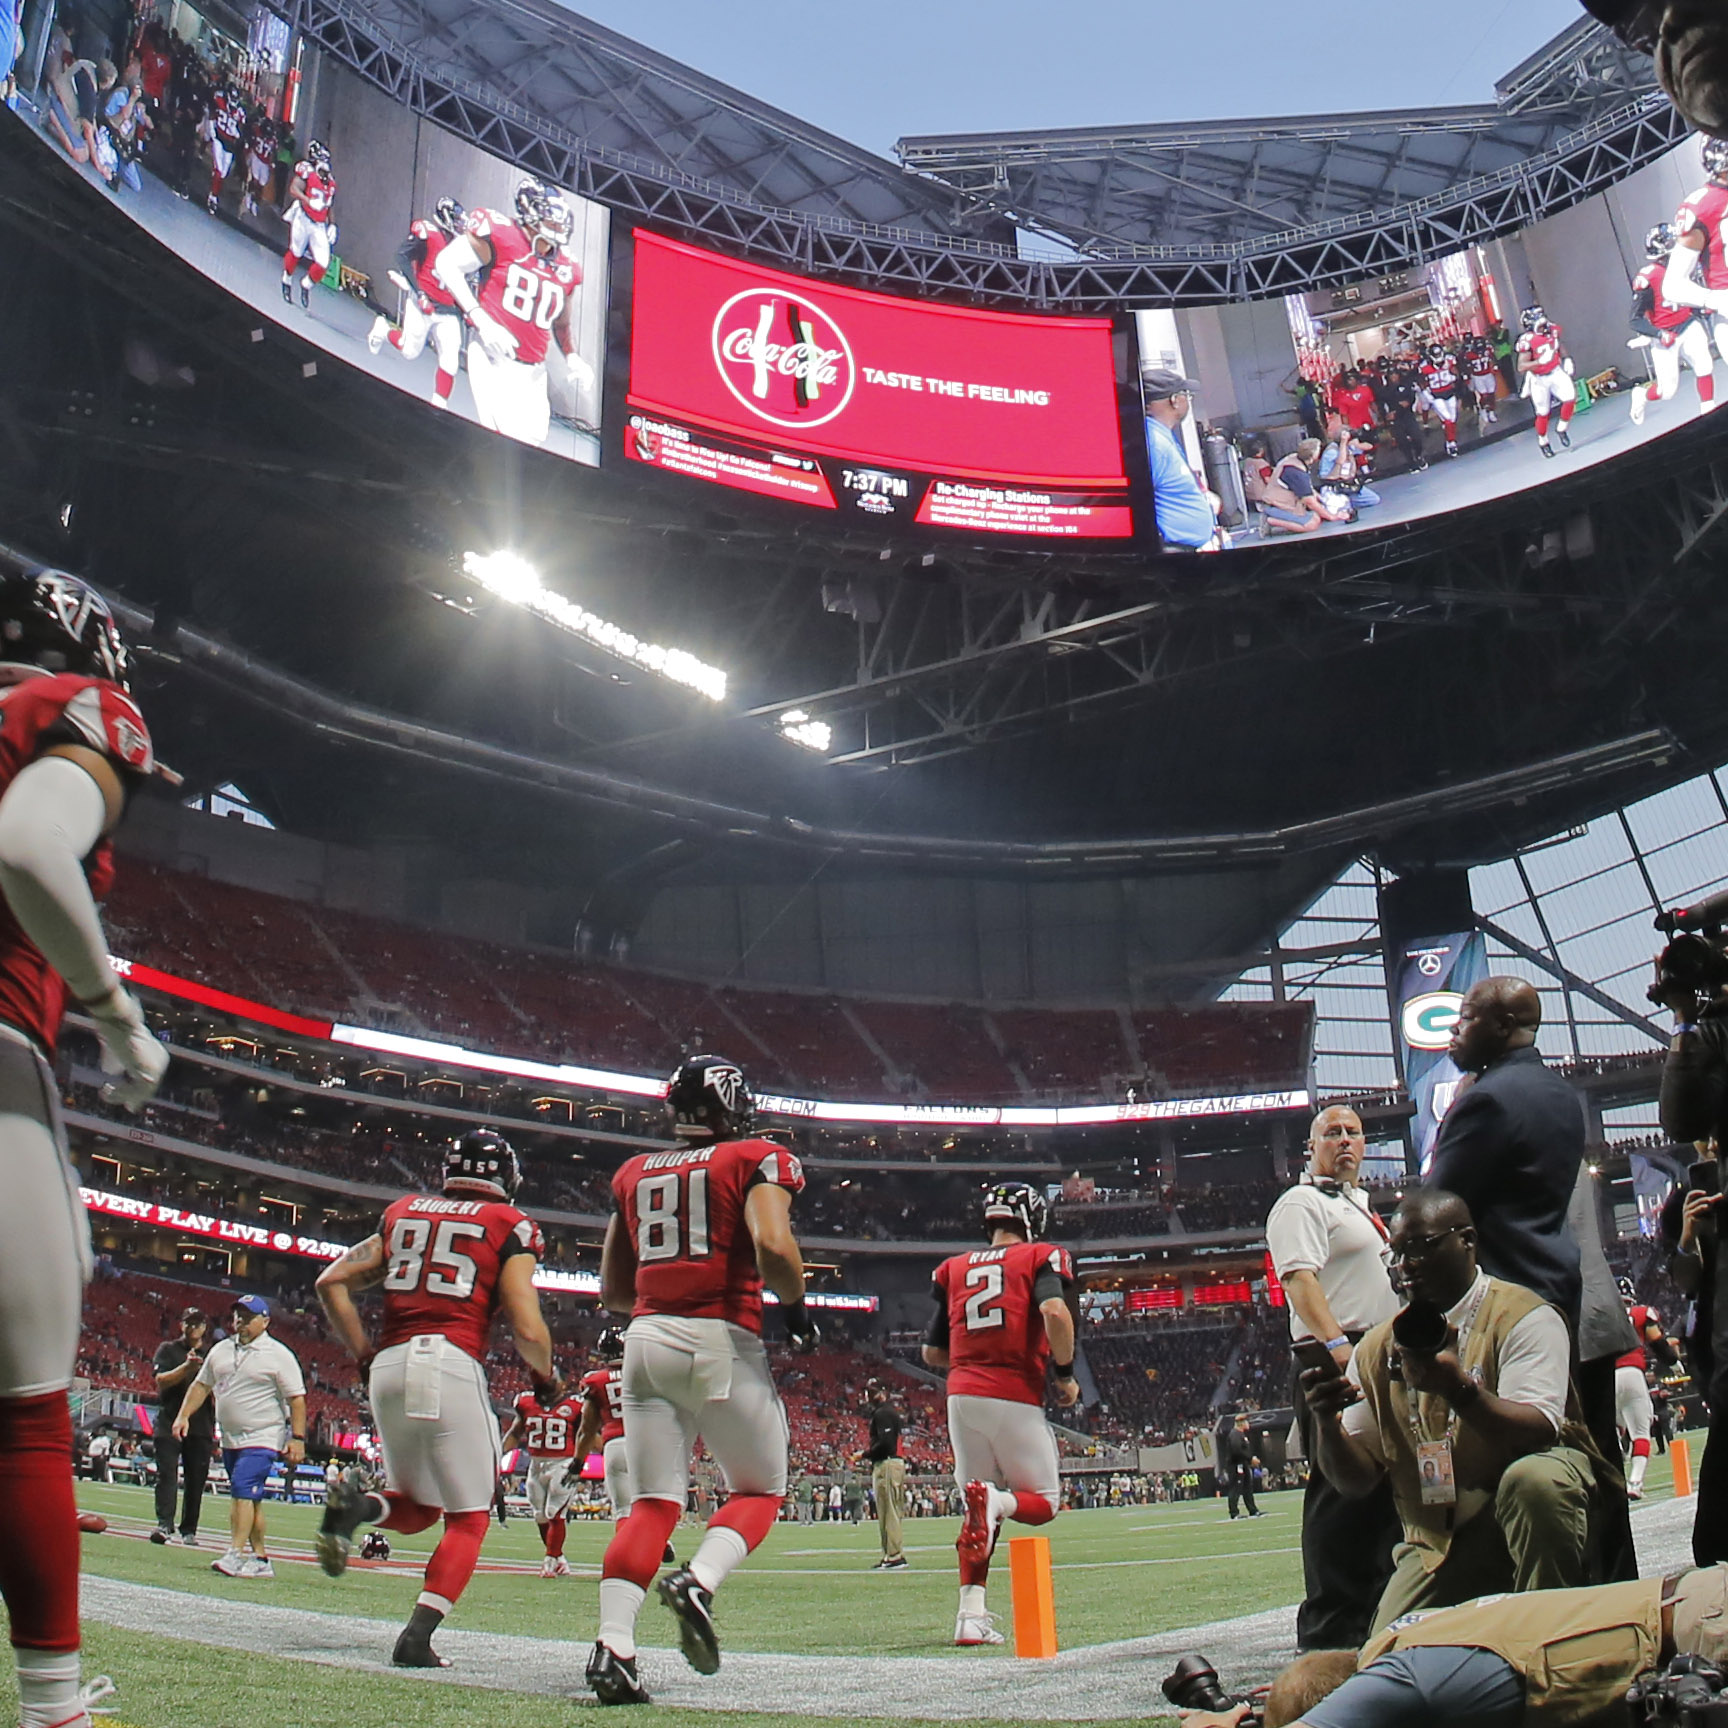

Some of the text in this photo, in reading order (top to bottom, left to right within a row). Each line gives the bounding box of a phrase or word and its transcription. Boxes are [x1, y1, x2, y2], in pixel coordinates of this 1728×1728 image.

[502, 263, 565, 330] 80
[722, 328, 843, 385] Coca-Cola
[862, 367, 1049, 406] TASTE THE FEELING
[630, 415, 690, 442] @joaobass
[700, 446, 716, 459] Rise
[842, 471, 908, 496] 7:37 PM
[936, 482, 1051, 505] Re-Charging Stations
[1116, 1093, 1293, 1119] 929THEGAME.COM
[643, 1146, 717, 1171] HOOPER
[78, 1187, 153, 1217] EVERY
[158, 1206, 214, 1231] PLAY
[218, 1220, 269, 1244] LIVE
[273, 1233, 293, 1249] @
[408, 1198, 485, 1215] SAUBERT
[637, 1168, 709, 1262] 81
[384, 1218, 485, 1298] 85
[969, 1248, 1007, 1264] RYAN
[966, 1264, 1003, 1330] 2
[526, 1416, 567, 1450] 28
